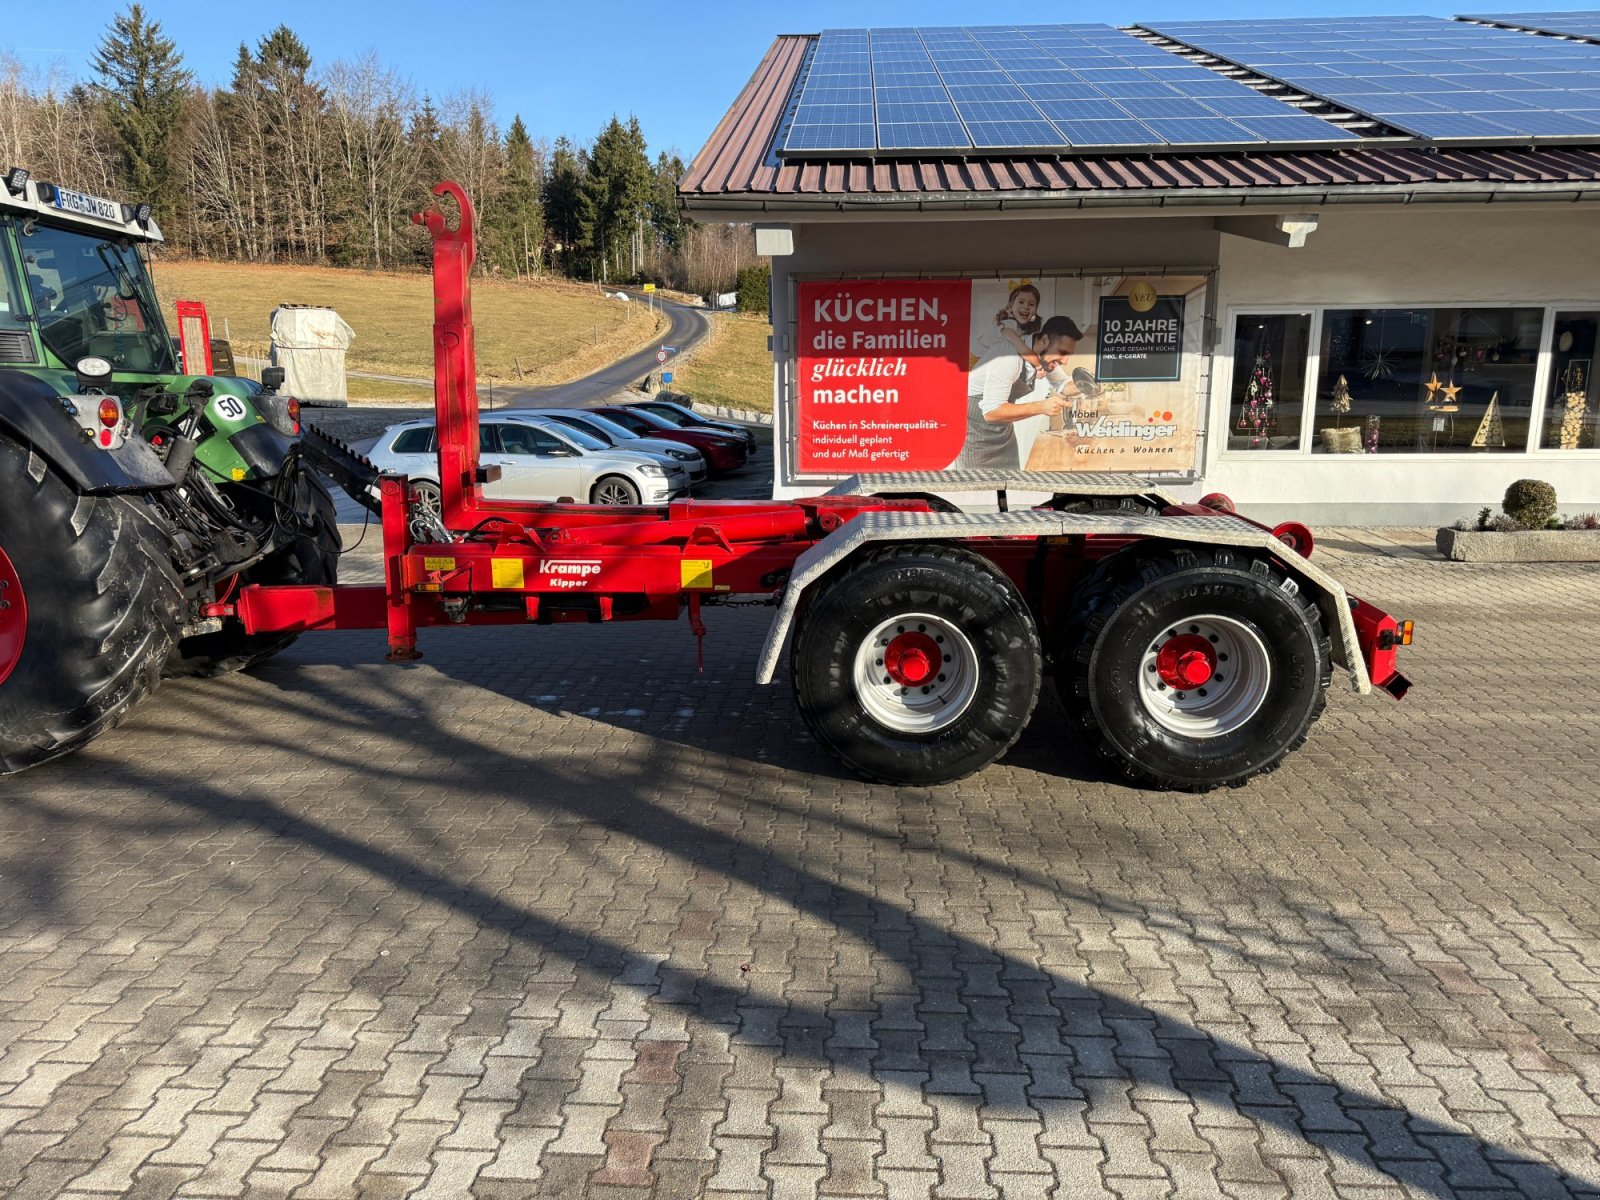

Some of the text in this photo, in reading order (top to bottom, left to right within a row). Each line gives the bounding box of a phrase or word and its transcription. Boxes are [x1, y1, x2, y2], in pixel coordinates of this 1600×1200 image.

[60, 191, 115, 219] FRG JW 820
[814, 292, 948, 327] KÜCHEN,
[1104, 319, 1178, 332] 10 JAHRE
[813, 328, 946, 350] die Familien
[1103, 332, 1177, 344] GARANTIE
[811, 356, 908, 383] glücklich
[813, 384, 899, 404] machen
[217, 397, 243, 418] 50
[1069, 410, 1099, 418] Möbel
[812, 420, 847, 430] Küchen
[849, 420, 858, 430] in
[860, 419, 938, 433] Schreinerqualität
[1075, 414, 1177, 441] Weidinger
[812, 434, 893, 447] individuell geplant
[812, 448, 910, 461] und auf Maß gefertigt
[1076, 446, 1115, 454] Küchen
[1133, 446, 1174, 454] Wohnen
[539, 559, 602, 577] Krampe
[550, 578, 588, 588] Kipper
